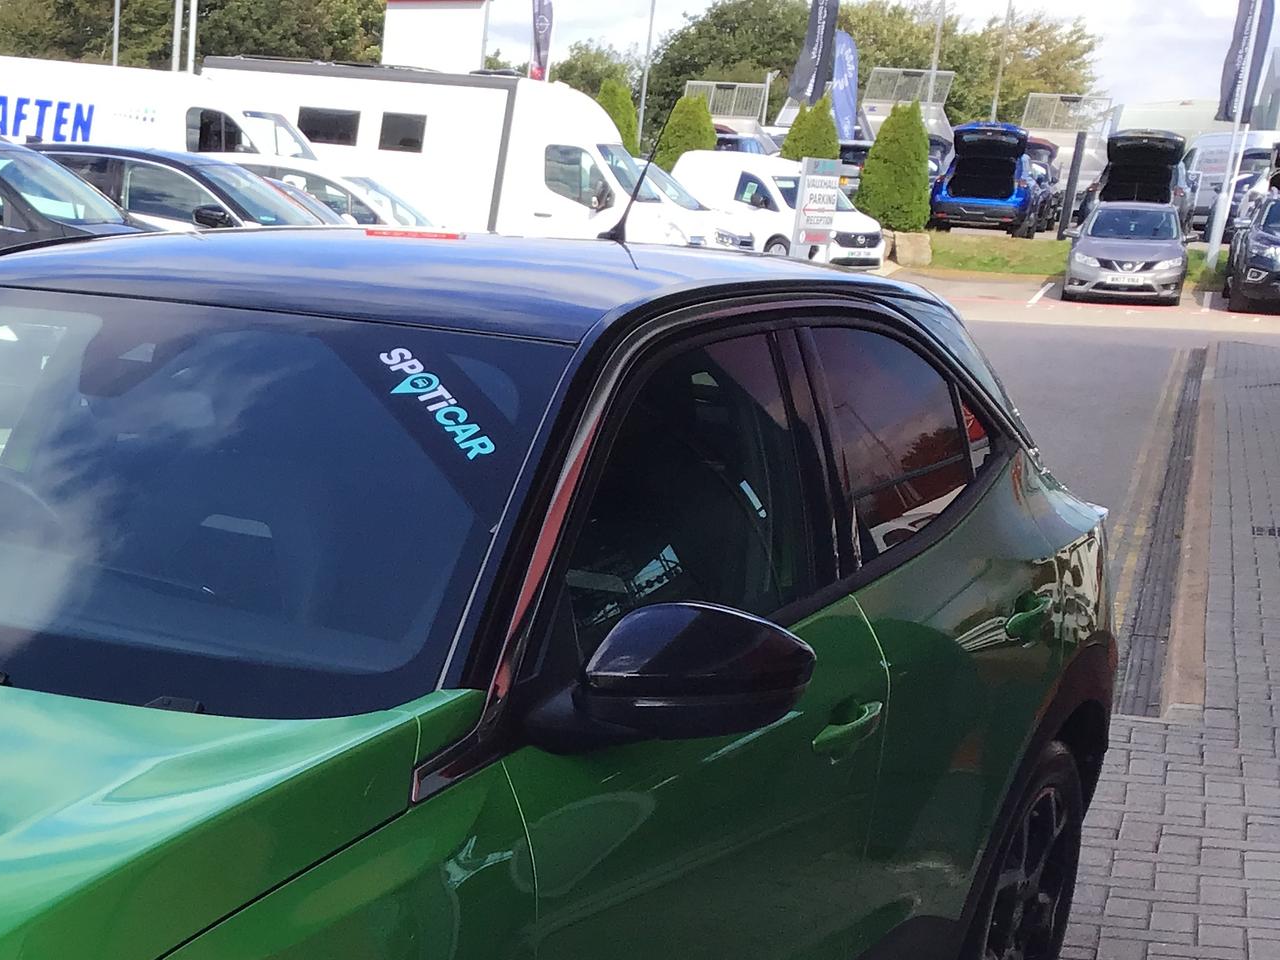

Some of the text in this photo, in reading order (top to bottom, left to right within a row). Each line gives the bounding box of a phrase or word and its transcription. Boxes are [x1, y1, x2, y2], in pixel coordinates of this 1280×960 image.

[806, 177, 838, 190] VAUXHALL
[808, 193, 837, 206] PARKING
[805, 215, 834, 226] RECEPTION
